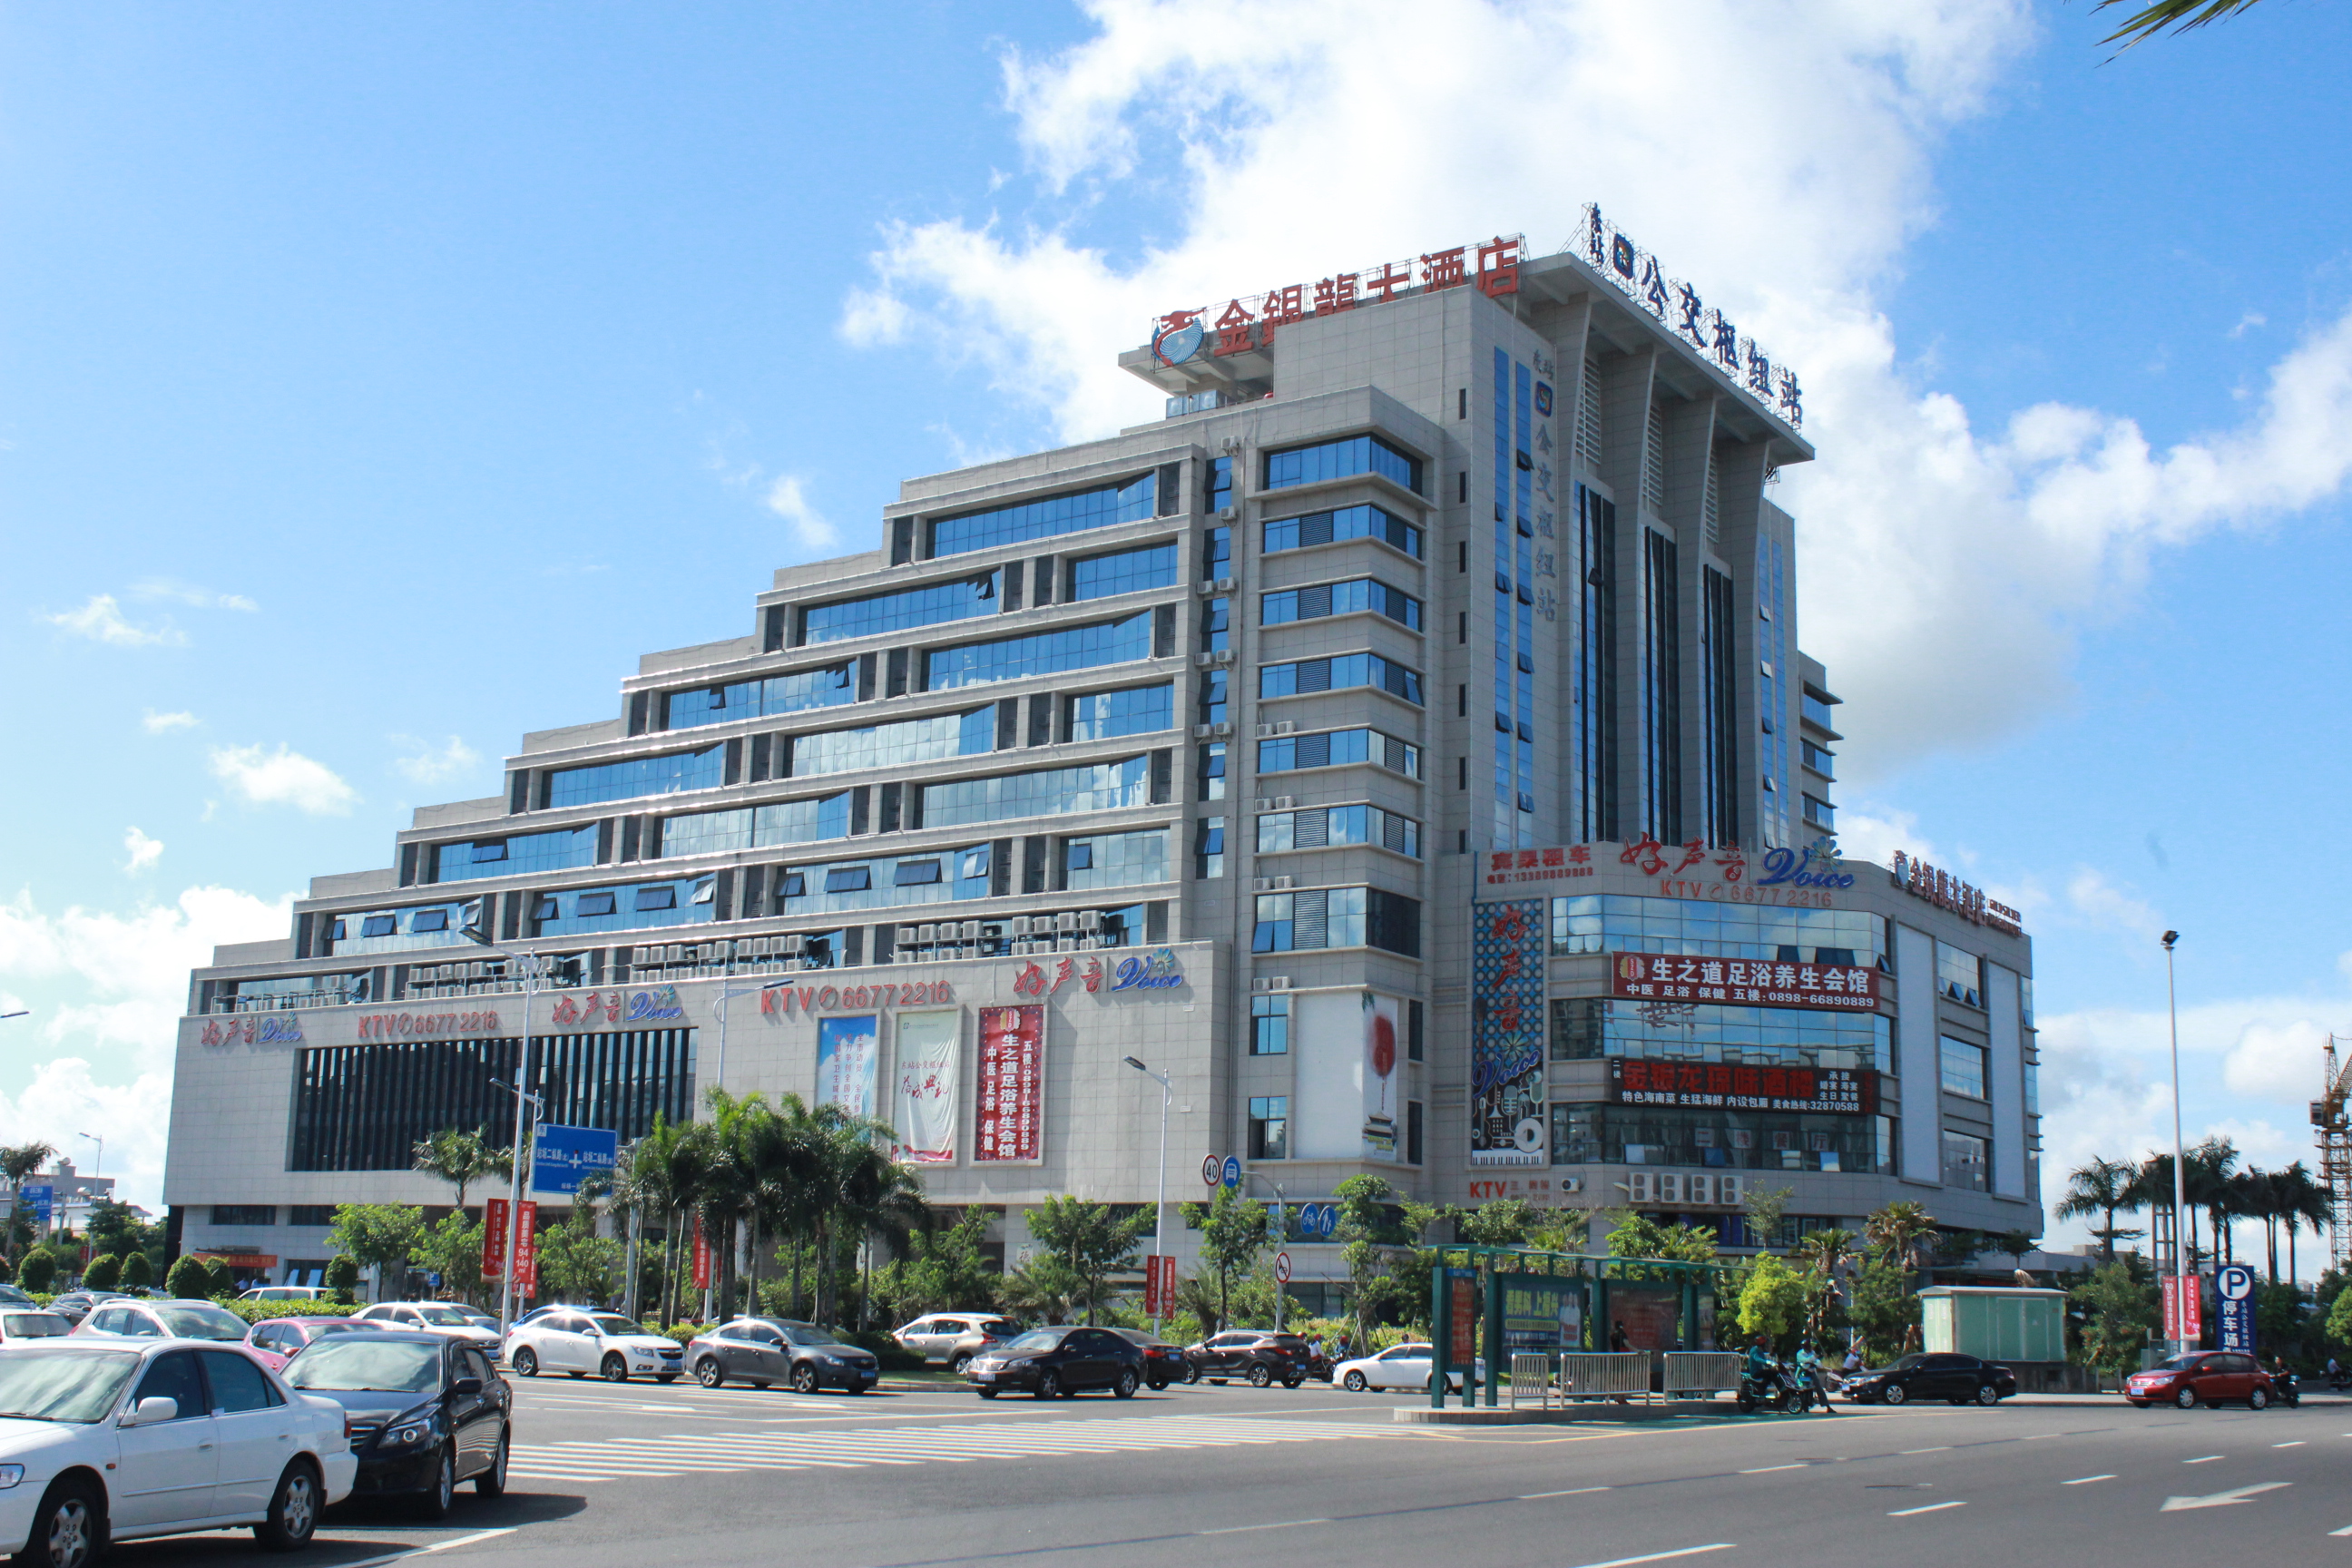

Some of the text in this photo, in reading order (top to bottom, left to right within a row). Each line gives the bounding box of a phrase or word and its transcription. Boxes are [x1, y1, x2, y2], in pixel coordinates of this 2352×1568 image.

[1536, 424, 1556, 622] 公交枢纽站
[1620, 832, 1855, 889] 好声音 Voice
[1661, 880, 1832, 906] KTV 6677 2216
[1014, 955, 1182, 995] 好声音 Voice
[1493, 905, 1528, 1031] 好声音
[1651, 958, 1869, 994] 生之道足浴养生会馆
[552, 991, 683, 1024] 好声音 Voice
[761, 980, 950, 1014] KTV 6677 2216
[1626, 985, 1875, 1007] 中医 足浴 保健 五楼:0898-66890889
[201, 1016, 302, 1046] 好声音 Voice
[358, 1010, 498, 1038] KTV 6677 2216
[1472, 1049, 1541, 1099] Voice
[1829, 1071, 1850, 1082] 承接
[984, 1046, 996, 1151] 中医 足浴 保健
[998, 1034, 1019, 1156] 生之道足浴养生会馆
[1622, 1092, 1676, 1104] 特色海南菜
[1681, 1093, 1722, 1106] 生猛海鲜
[1727, 1095, 1769, 1109] 内设包厢
[1819, 1092, 1837, 1101] 生日
[1206, 1163, 1217, 1179] 40
[1470, 1181, 1506, 1198] KTV
[2227, 1271, 2246, 1296] P
[2222, 1300, 2239, 1348] 停车场
